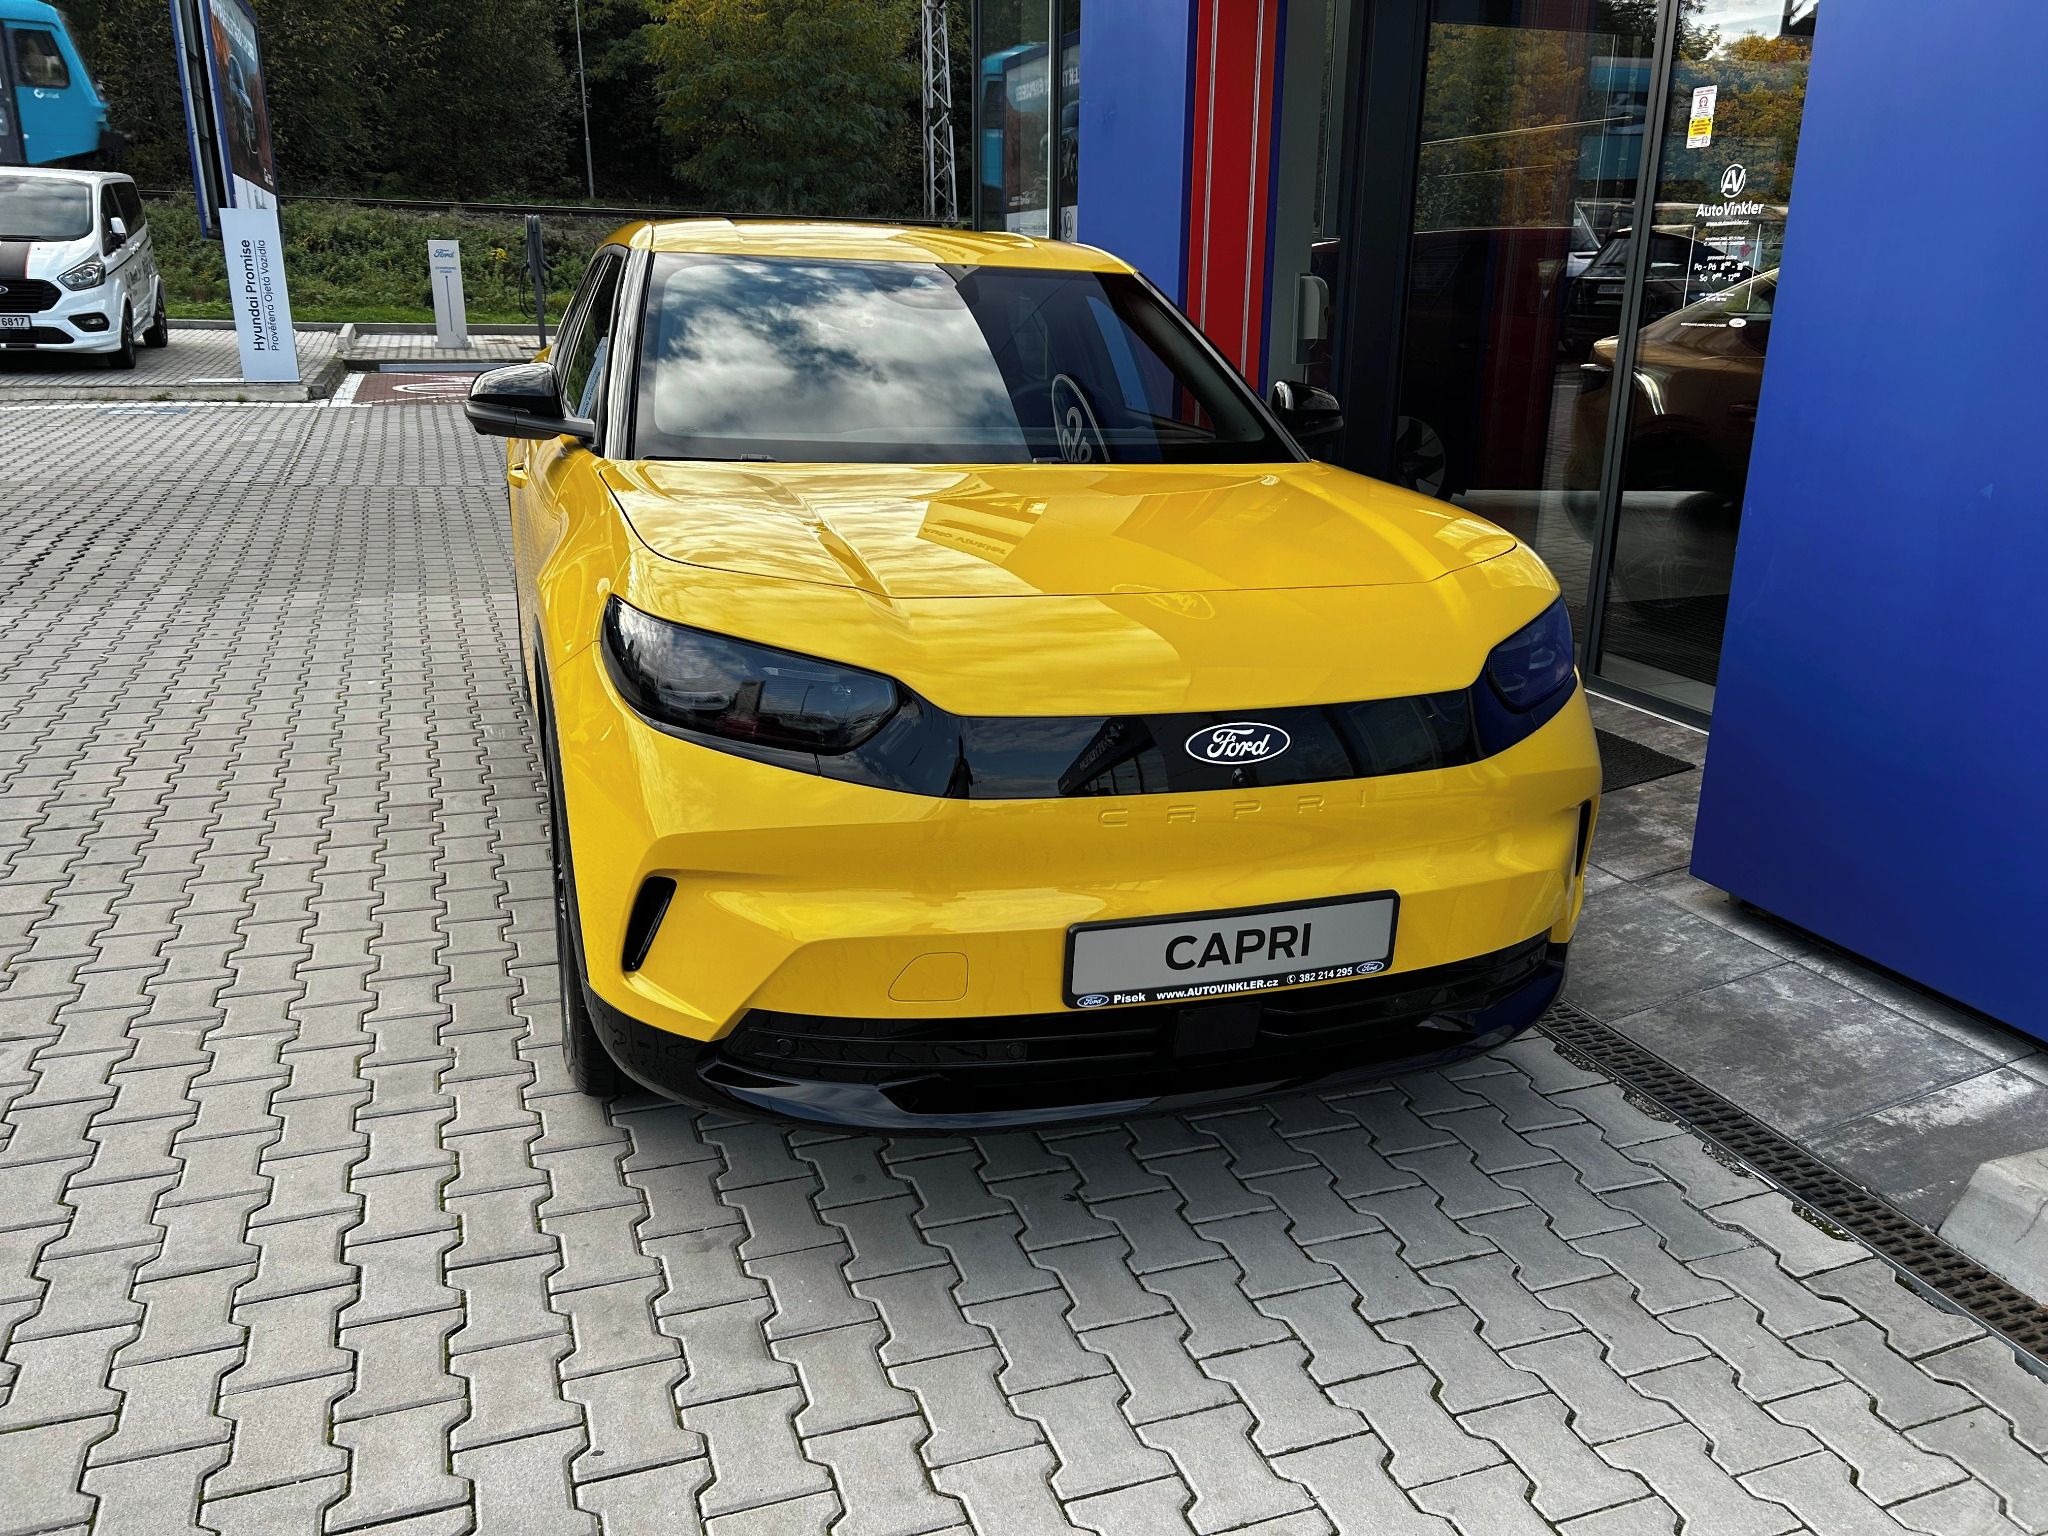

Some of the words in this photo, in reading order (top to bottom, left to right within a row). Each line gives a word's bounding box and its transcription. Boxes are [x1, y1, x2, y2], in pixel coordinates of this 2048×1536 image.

[1696, 200, 1765, 218] AutoVinkler
[240, 239, 257, 293] Promise
[258, 239, 270, 276] Vozidla
[433, 248, 455, 258] Ford
[261, 277, 274, 302] Ojetá
[1, 317, 25, 326] 6817
[246, 296, 266, 351] Hyundai
[265, 304, 280, 351] Prověřená
[1206, 728, 1271, 758] Ford
[1165, 922, 1312, 971] CAPRI
[1113, 992, 1146, 1004] Písek
[1156, 979, 1279, 1000] www.AUTOVINKLER.cz
[1298, 973, 1316, 983] 382
[1318, 970, 1334, 980] 214
[1336, 967, 1353, 977] 295
